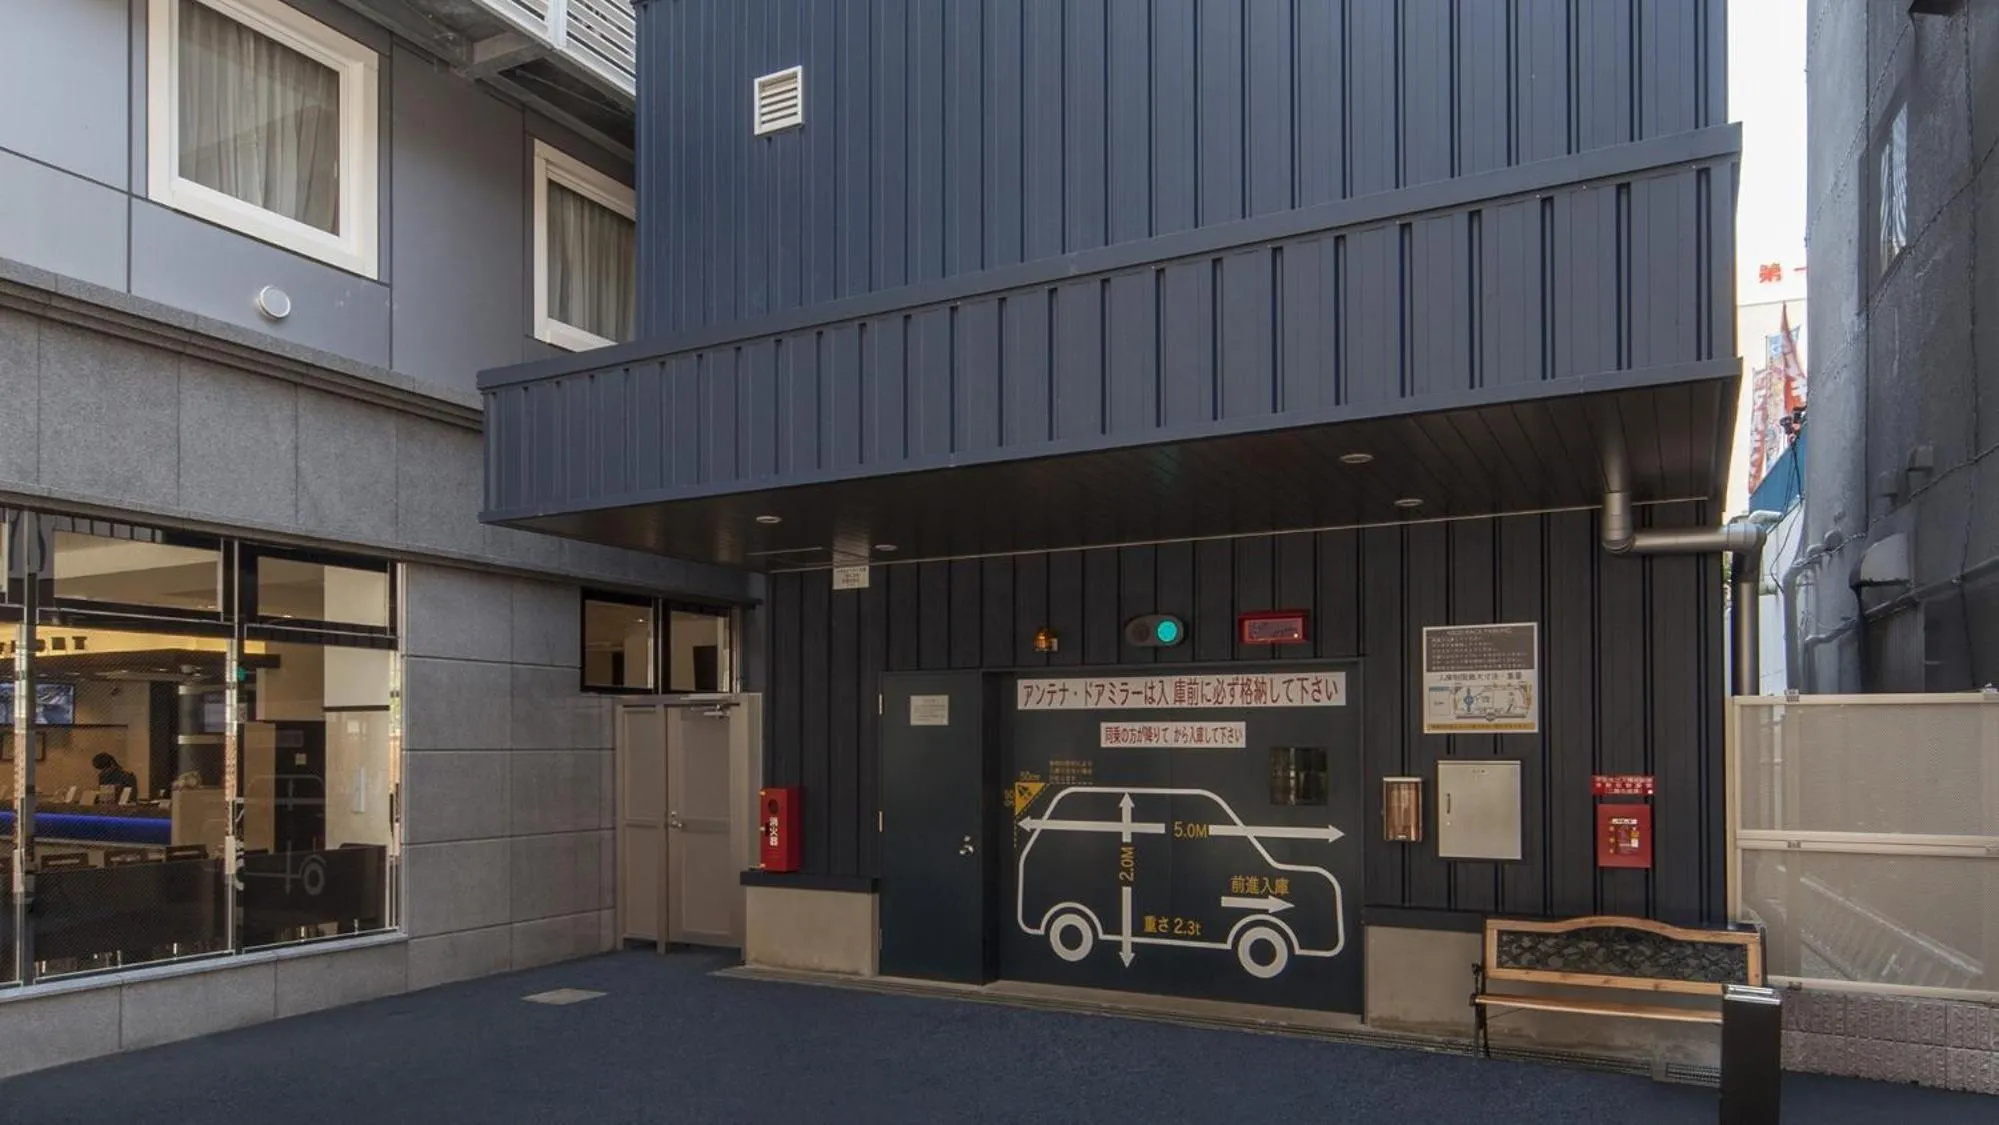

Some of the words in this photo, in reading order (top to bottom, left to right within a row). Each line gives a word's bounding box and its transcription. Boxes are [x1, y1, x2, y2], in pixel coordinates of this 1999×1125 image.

[1023, 678, 1339, 706] アンテナ・ドアミラーは入庫前に必ず格納して下さい
[1104, 726, 1242, 745] 同乗の方が降りてから入庫して下さい
[1174, 821, 1208, 839] 5.0M
[1120, 847, 1134, 882] 2.0M
[1231, 875, 1290, 895] 前進入庫
